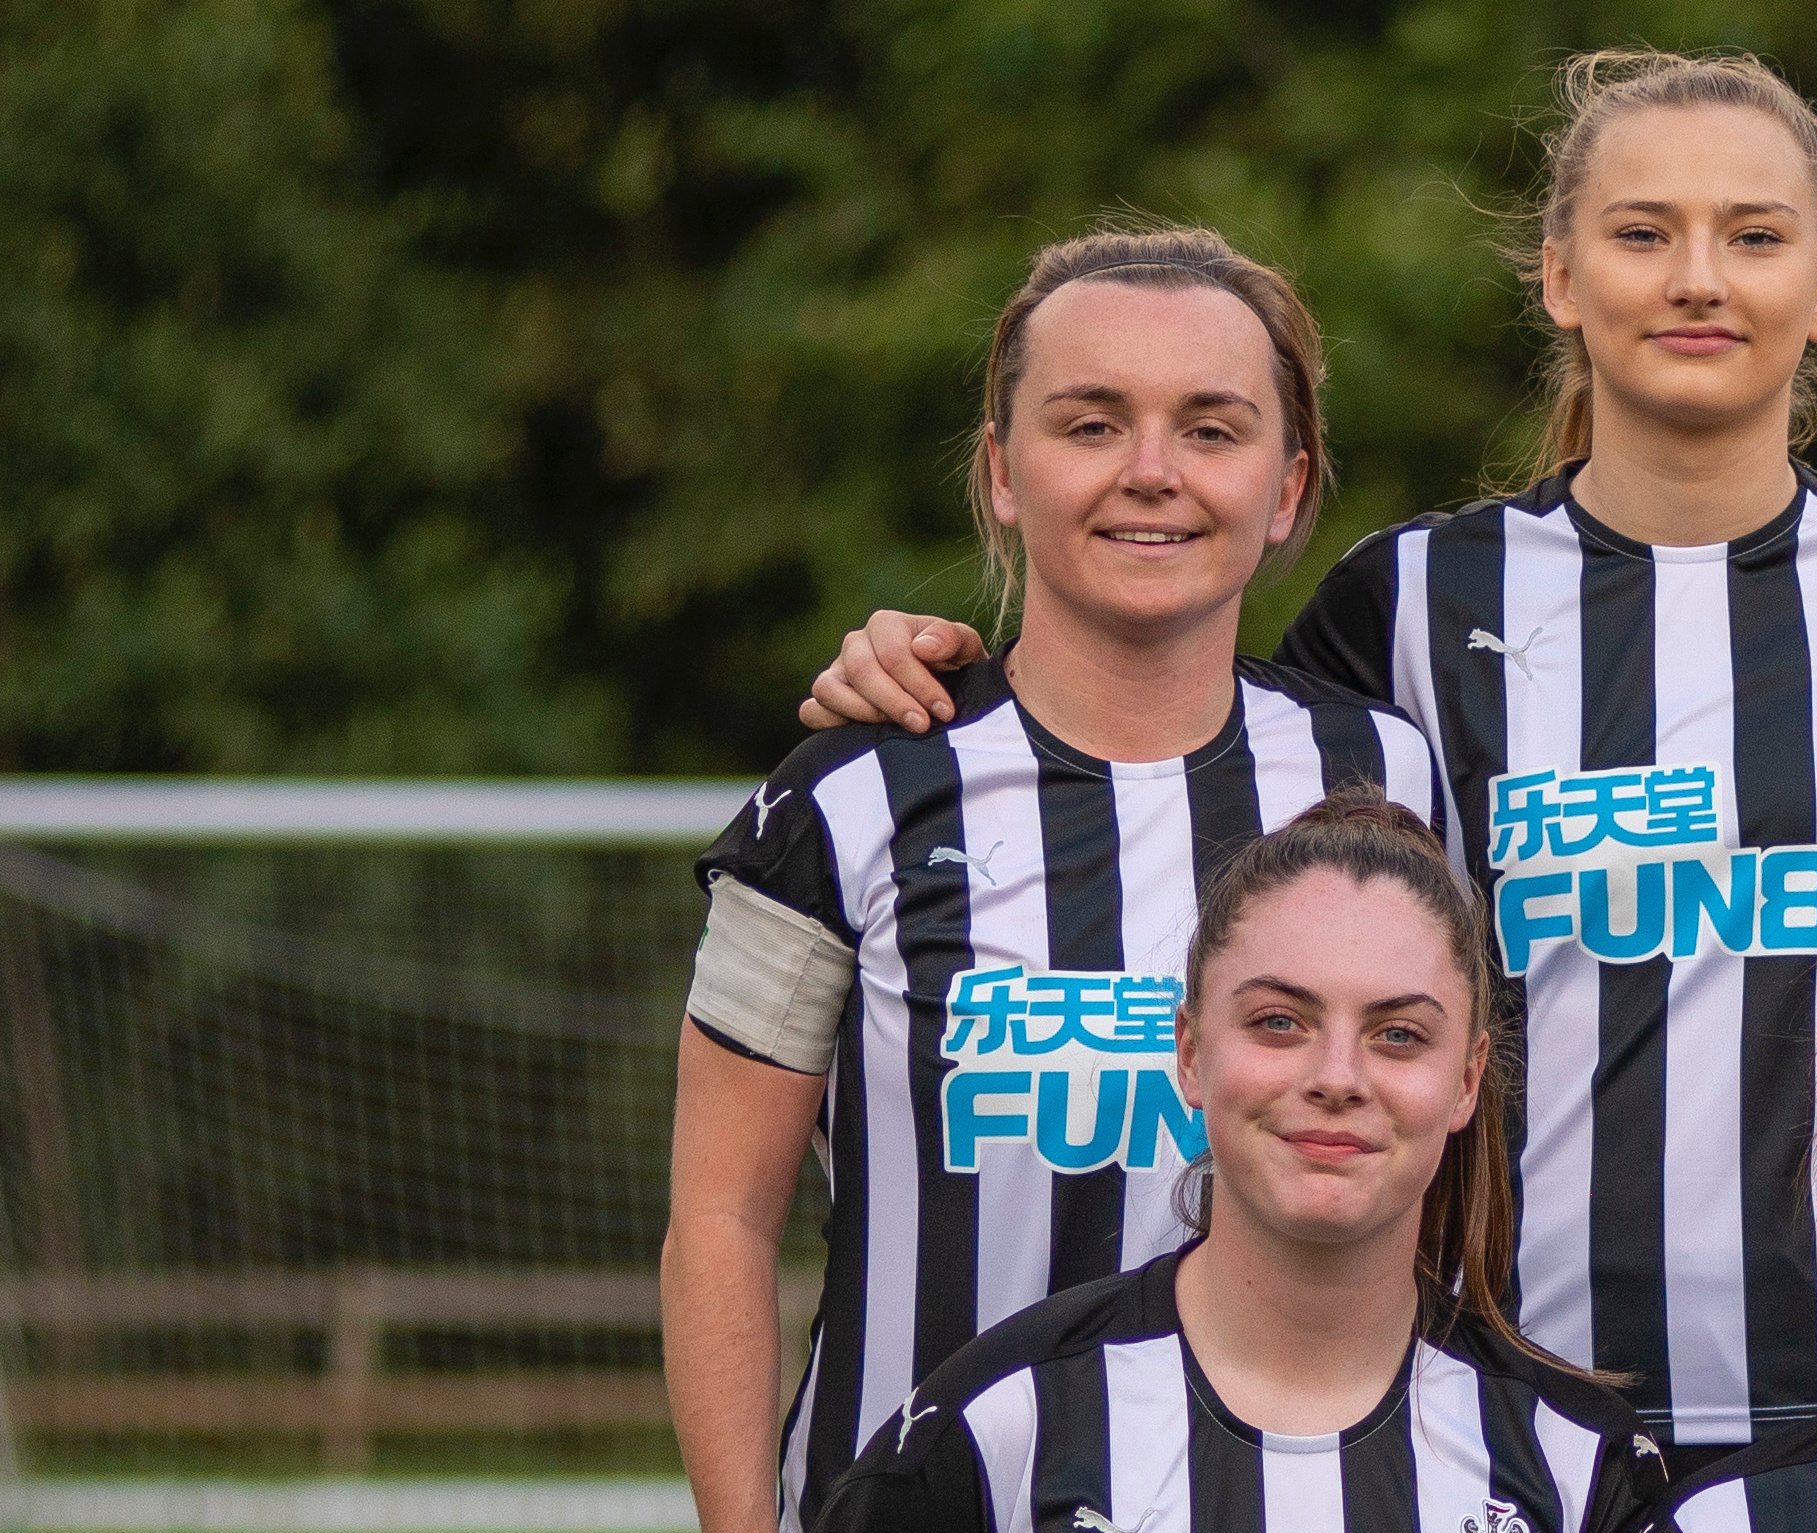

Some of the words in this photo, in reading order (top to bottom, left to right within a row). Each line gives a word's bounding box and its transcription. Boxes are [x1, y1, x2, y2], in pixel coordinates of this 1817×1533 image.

[1491, 766, 1717, 863] 乐天堂
[945, 965, 1184, 1056] 乐天堂
[944, 1069, 1210, 1168] FUN
